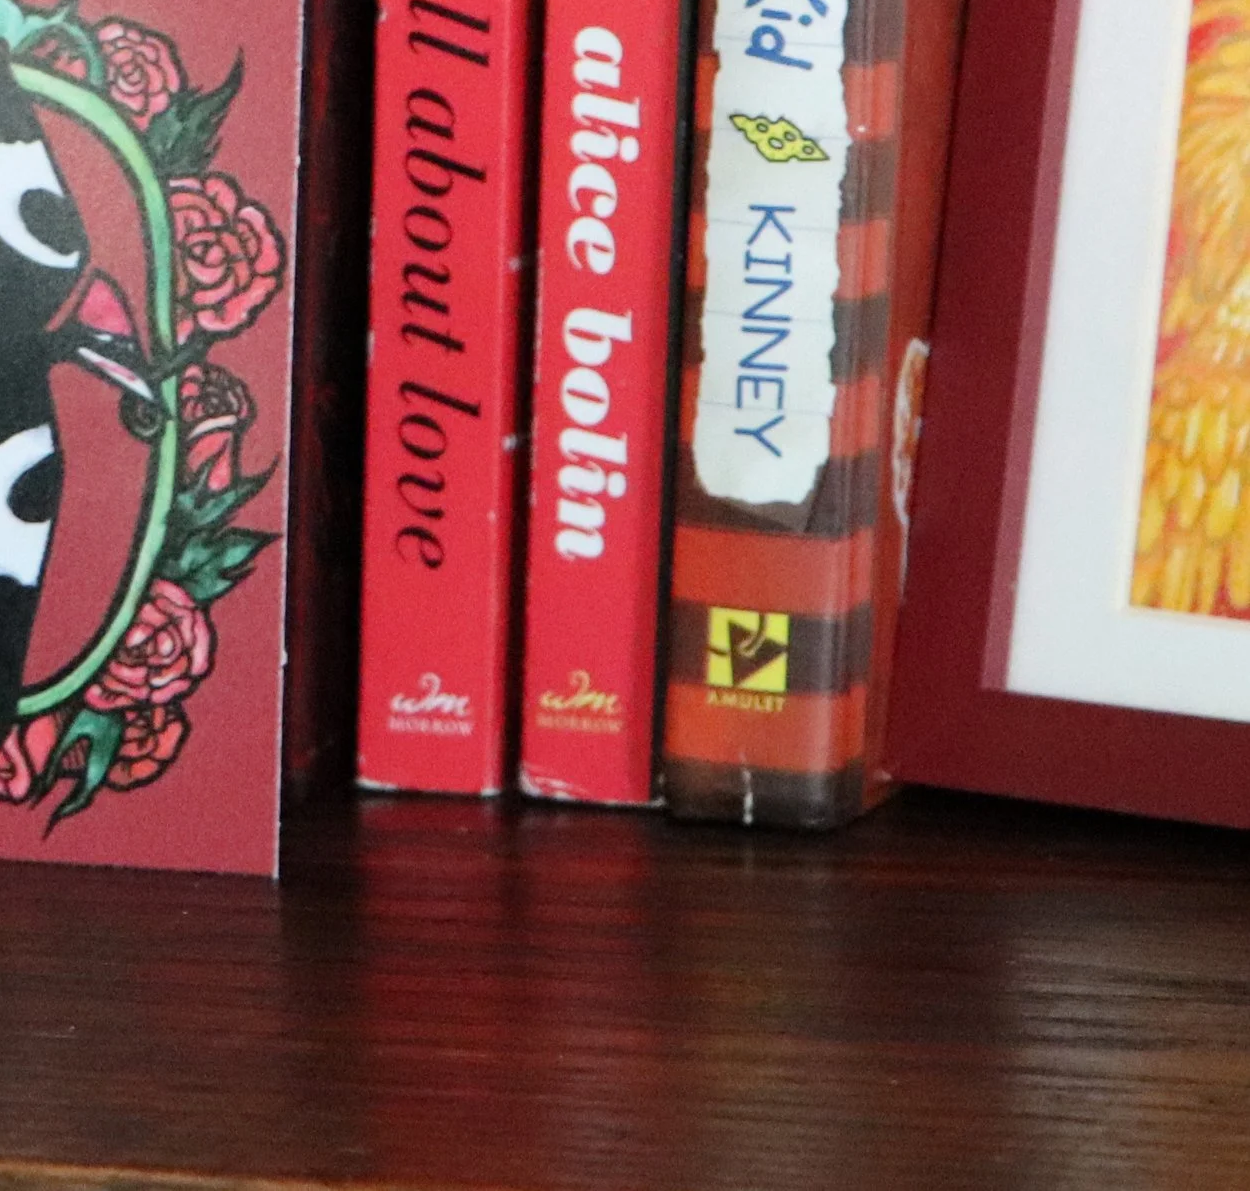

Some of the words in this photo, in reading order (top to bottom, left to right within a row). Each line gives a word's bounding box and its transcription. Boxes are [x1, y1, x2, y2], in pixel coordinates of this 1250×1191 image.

[400, 88, 486, 352] about
[567, 27, 640, 274] alice
[555, 308, 632, 558] bolin
[734, 205, 796, 457] KINNEY
[397, 381, 481, 569] love
